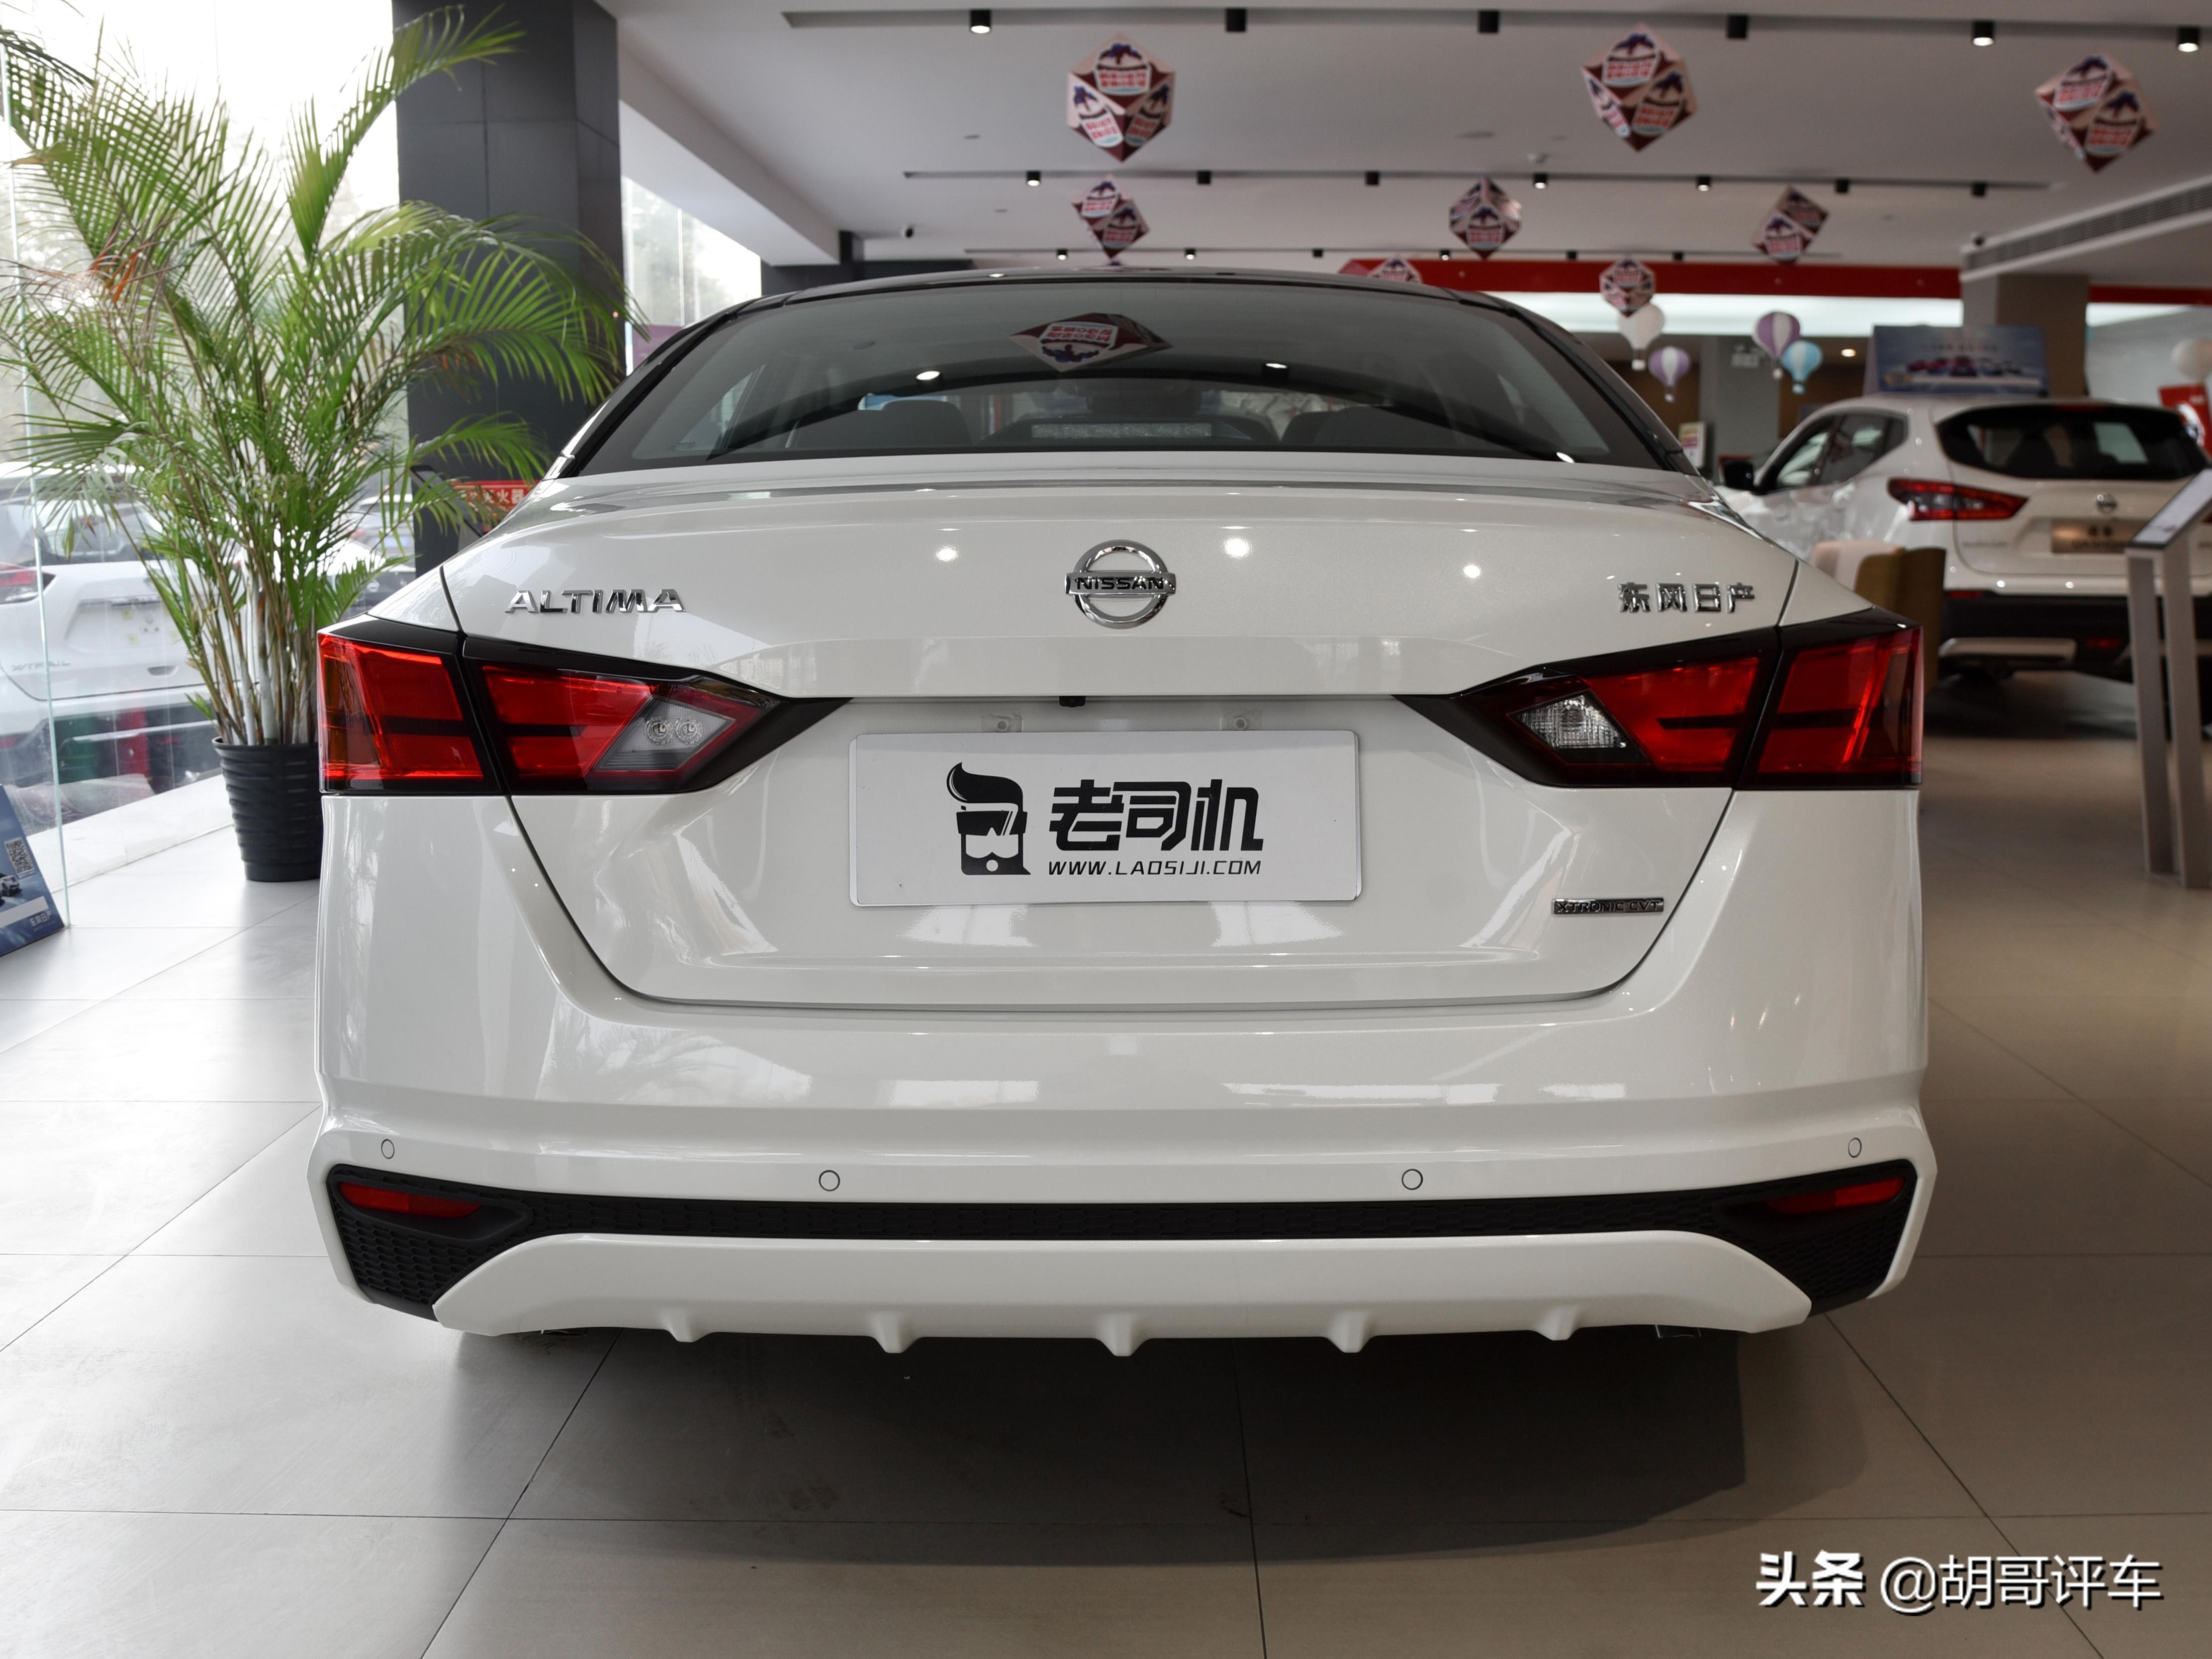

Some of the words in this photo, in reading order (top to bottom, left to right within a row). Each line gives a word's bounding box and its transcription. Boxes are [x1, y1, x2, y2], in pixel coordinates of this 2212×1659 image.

[1075, 577, 1164, 590] NISSAN
[505, 589, 687, 614] ALTIMA
[1617, 582, 1755, 613] 东风日产
[1049, 779, 1264, 851] 老司机
[1049, 861, 1261, 875] WWW.LAOSIJI.COM
[1557, 900, 1625, 912] XTRONIC
[1629, 899, 1662, 911] CVT
